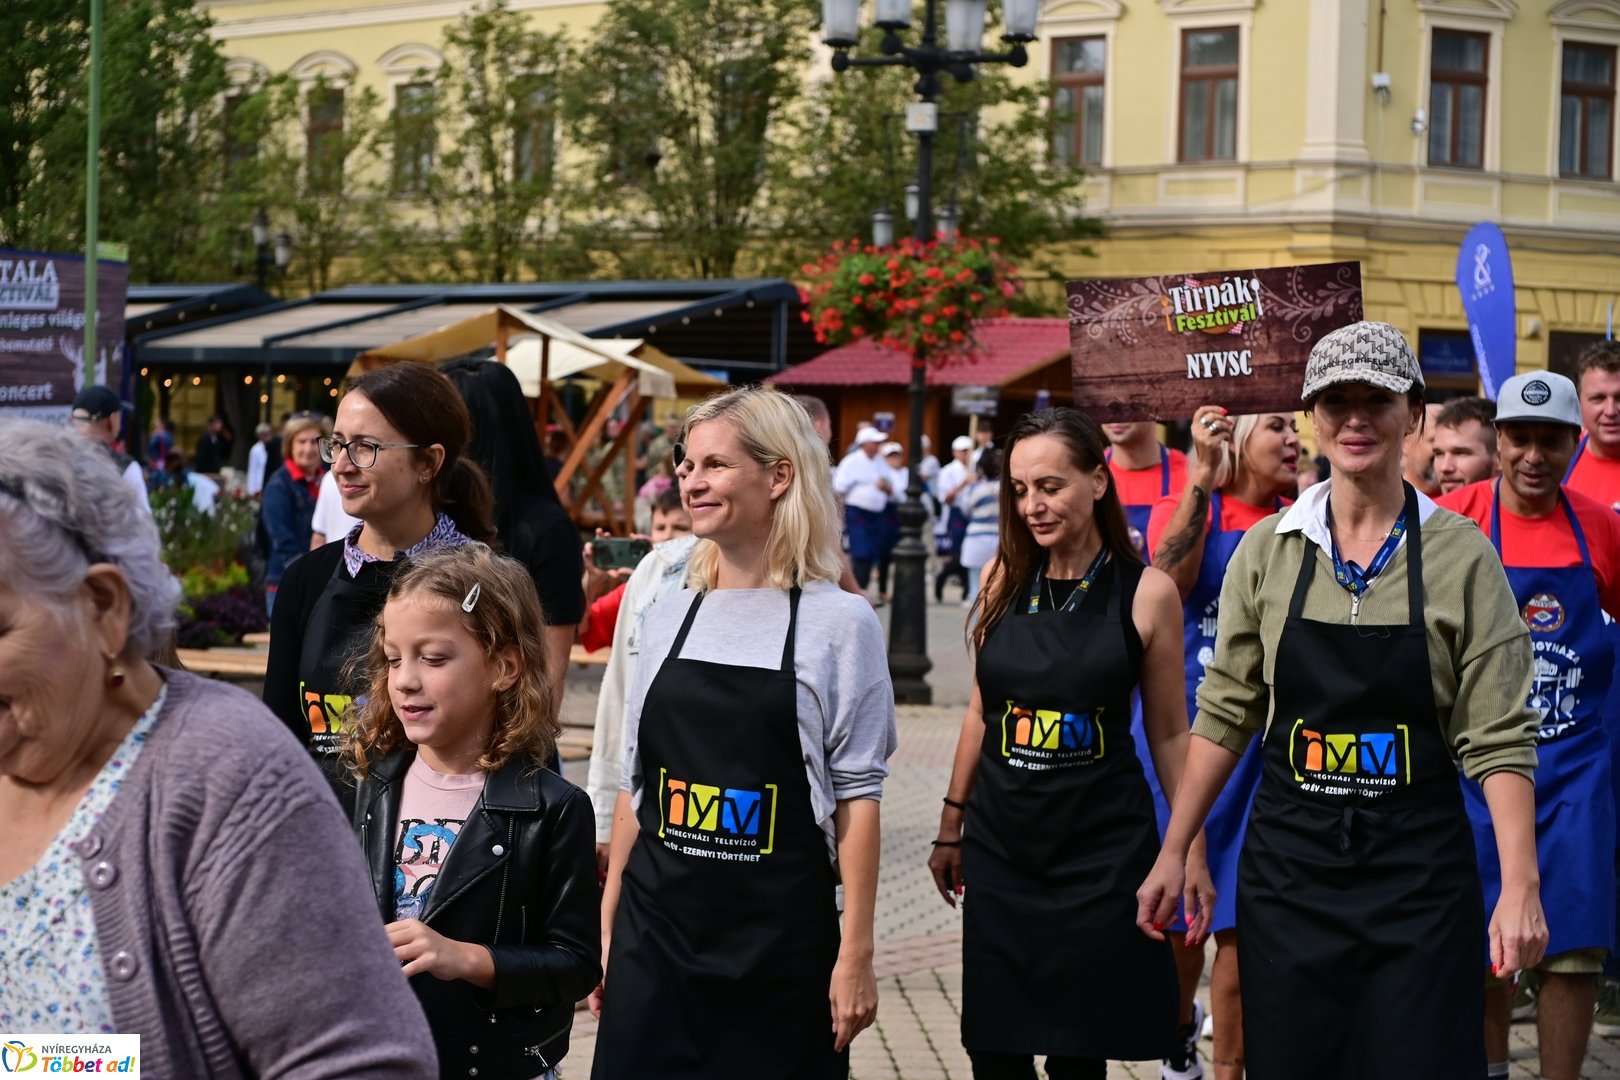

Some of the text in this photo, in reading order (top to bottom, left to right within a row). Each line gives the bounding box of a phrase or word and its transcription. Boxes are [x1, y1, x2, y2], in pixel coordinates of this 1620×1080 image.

[1168, 276, 1253, 314] Tirpák
[1176, 302, 1257, 333] Fesztivál
[1186, 349, 1253, 379] NYVSC
[1300, 782, 1311, 791] 40
[1310, 782, 1321, 793] ÉV
[1325, 786, 1357, 796] EZERNYI
[1356, 777, 1397, 786] TELEVÍZIÓ
[715, 836, 757, 847] TELEVÍZIÓ
[683, 846, 716, 859] EZERNYI
[717, 850, 761, 862] TÖRTÉNET
